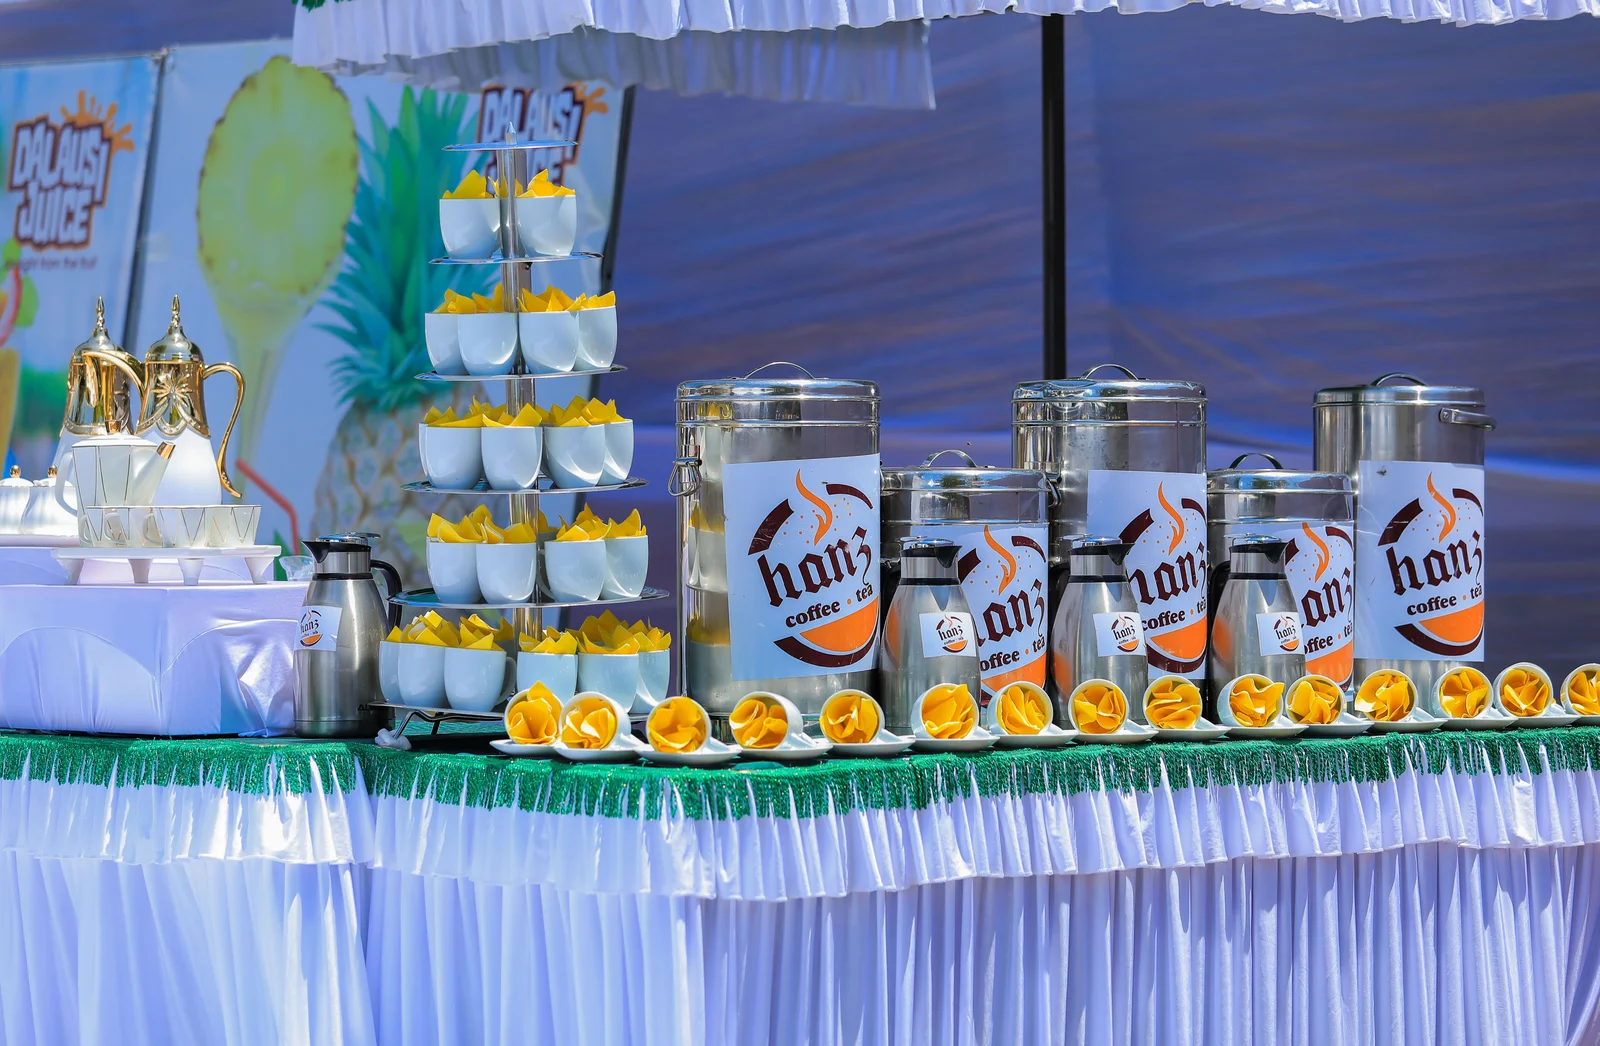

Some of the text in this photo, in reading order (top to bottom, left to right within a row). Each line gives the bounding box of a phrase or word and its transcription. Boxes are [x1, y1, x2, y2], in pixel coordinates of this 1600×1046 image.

[10, 120, 111, 203] DALAUSI
[17, 182, 93, 246] JUICE
[757, 526, 872, 608] hanz
[1386, 530, 1483, 596] hanz
[785, 585, 873, 628] coffee tea
[976, 578, 1045, 647] anz
[1301, 567, 1352, 629] anz
[1407, 584, 1483, 616] coffee tea
[938, 625, 963, 641] hanz
[1112, 625, 1136, 640] hanz
[1275, 625, 1297, 640] hanz
[980, 650, 1020, 671] offee
